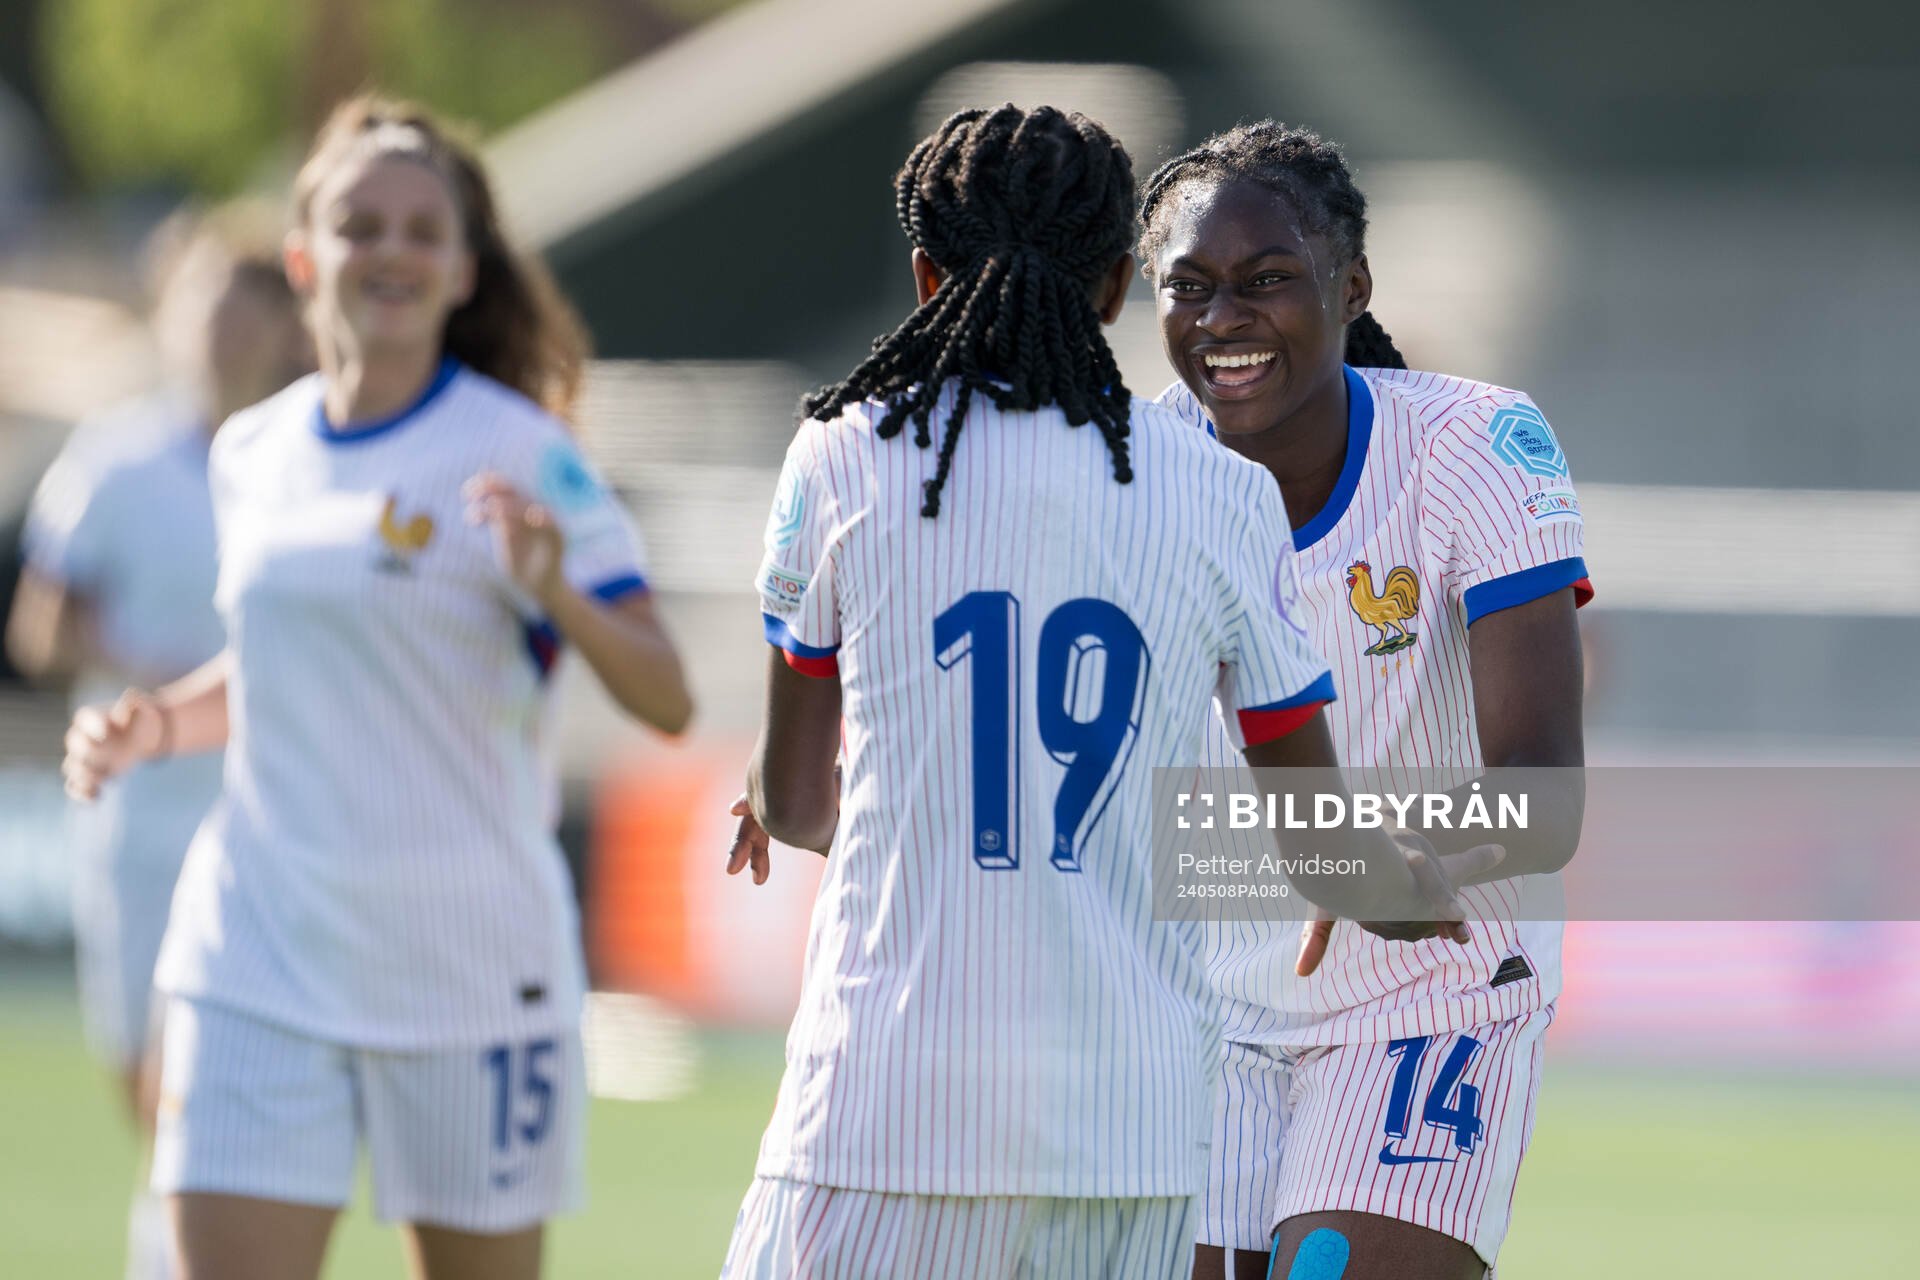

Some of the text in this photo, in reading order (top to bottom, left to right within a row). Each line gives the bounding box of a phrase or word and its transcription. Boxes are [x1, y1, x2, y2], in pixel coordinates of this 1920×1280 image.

[1523, 492, 1547, 507] UEFA
[933, 590, 1152, 874] 19
[481, 1038, 557, 1151] 15
[1384, 1033, 1485, 1157] 14
